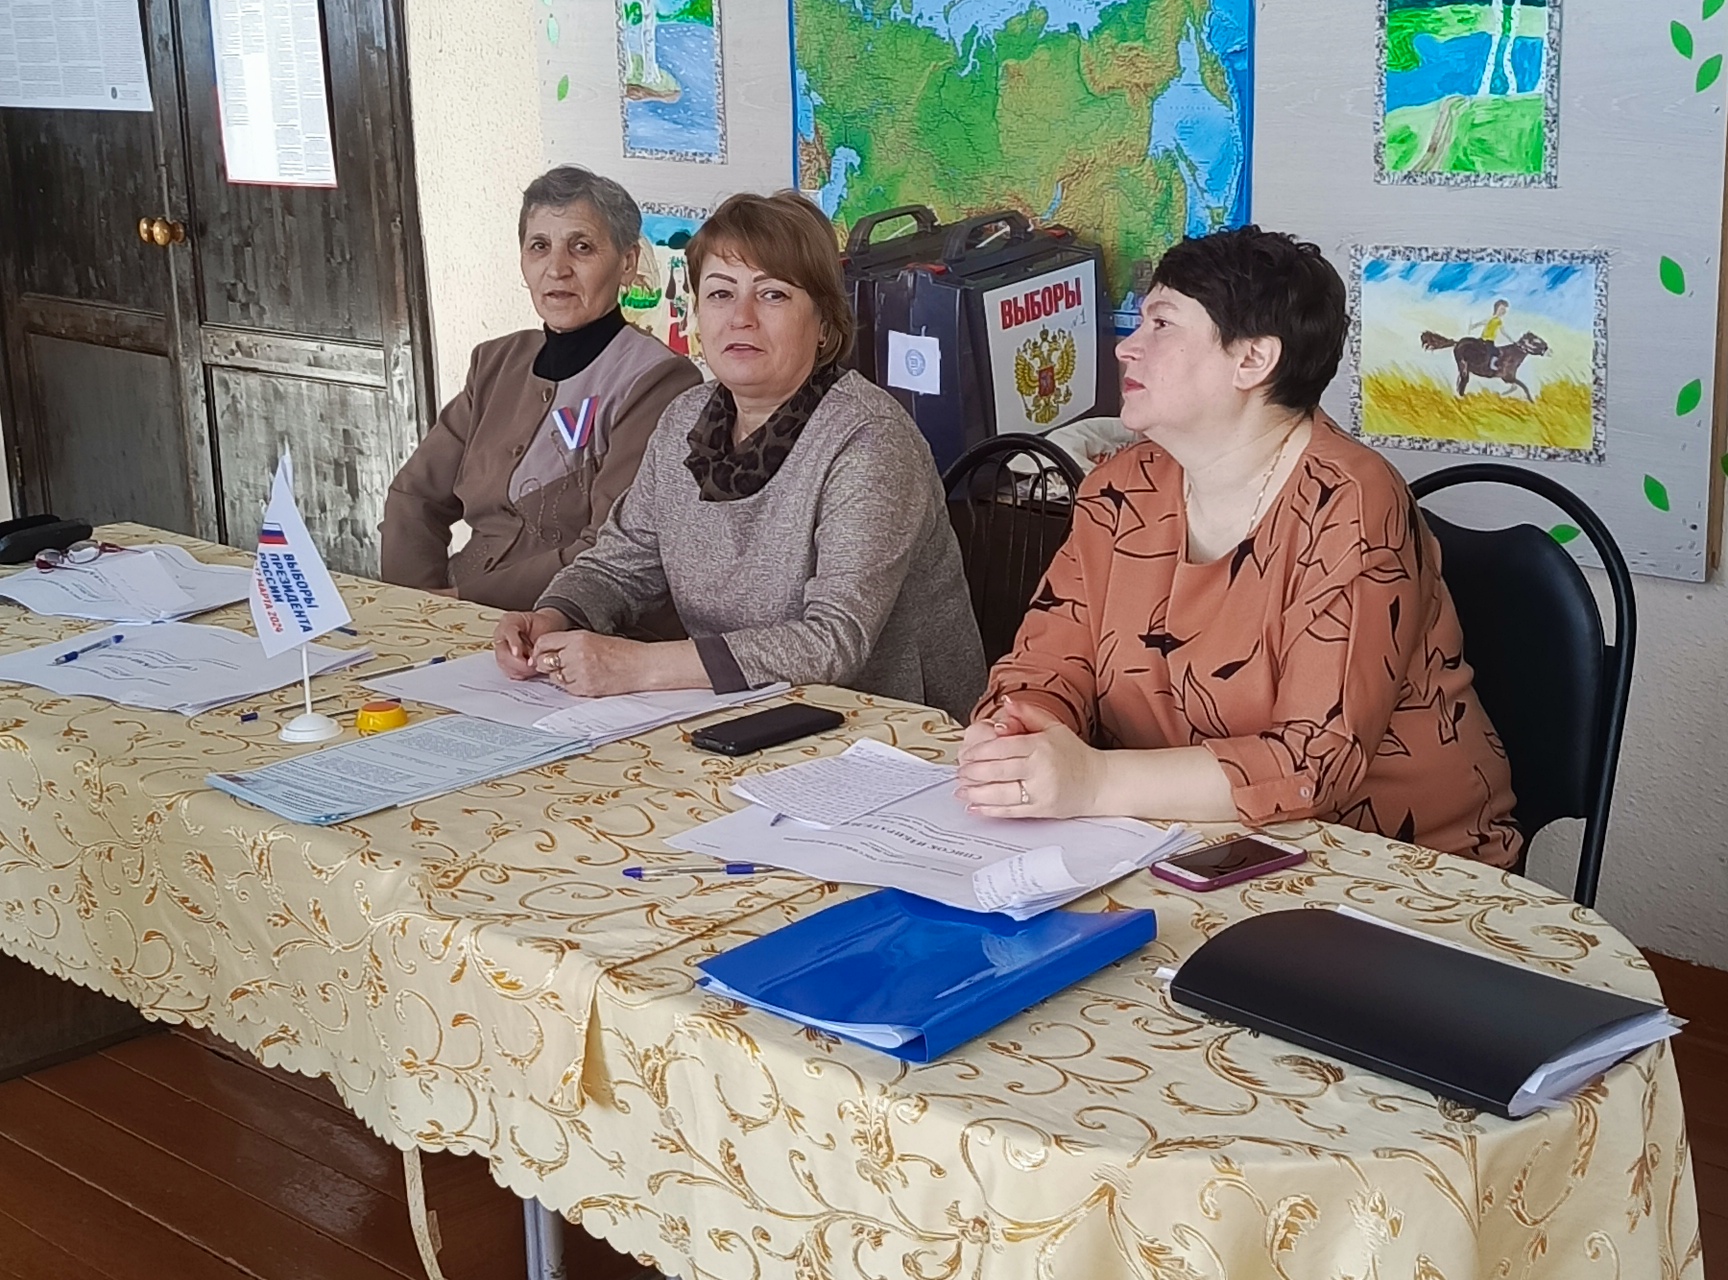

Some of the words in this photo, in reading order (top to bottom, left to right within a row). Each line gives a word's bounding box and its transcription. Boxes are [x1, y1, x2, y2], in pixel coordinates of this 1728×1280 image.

[1000, 277, 1082, 330] ВЫБОРЫ
[259, 553, 284, 602] РОССИИ
[269, 554, 313, 632] ПРЕЗИДЕНТА
[284, 554, 319, 608] ВЫБОРЫ
[256, 578, 274, 610] МАРТА
[267, 611, 284, 633] 2024
[927, 844, 983, 861] СПИСОК
